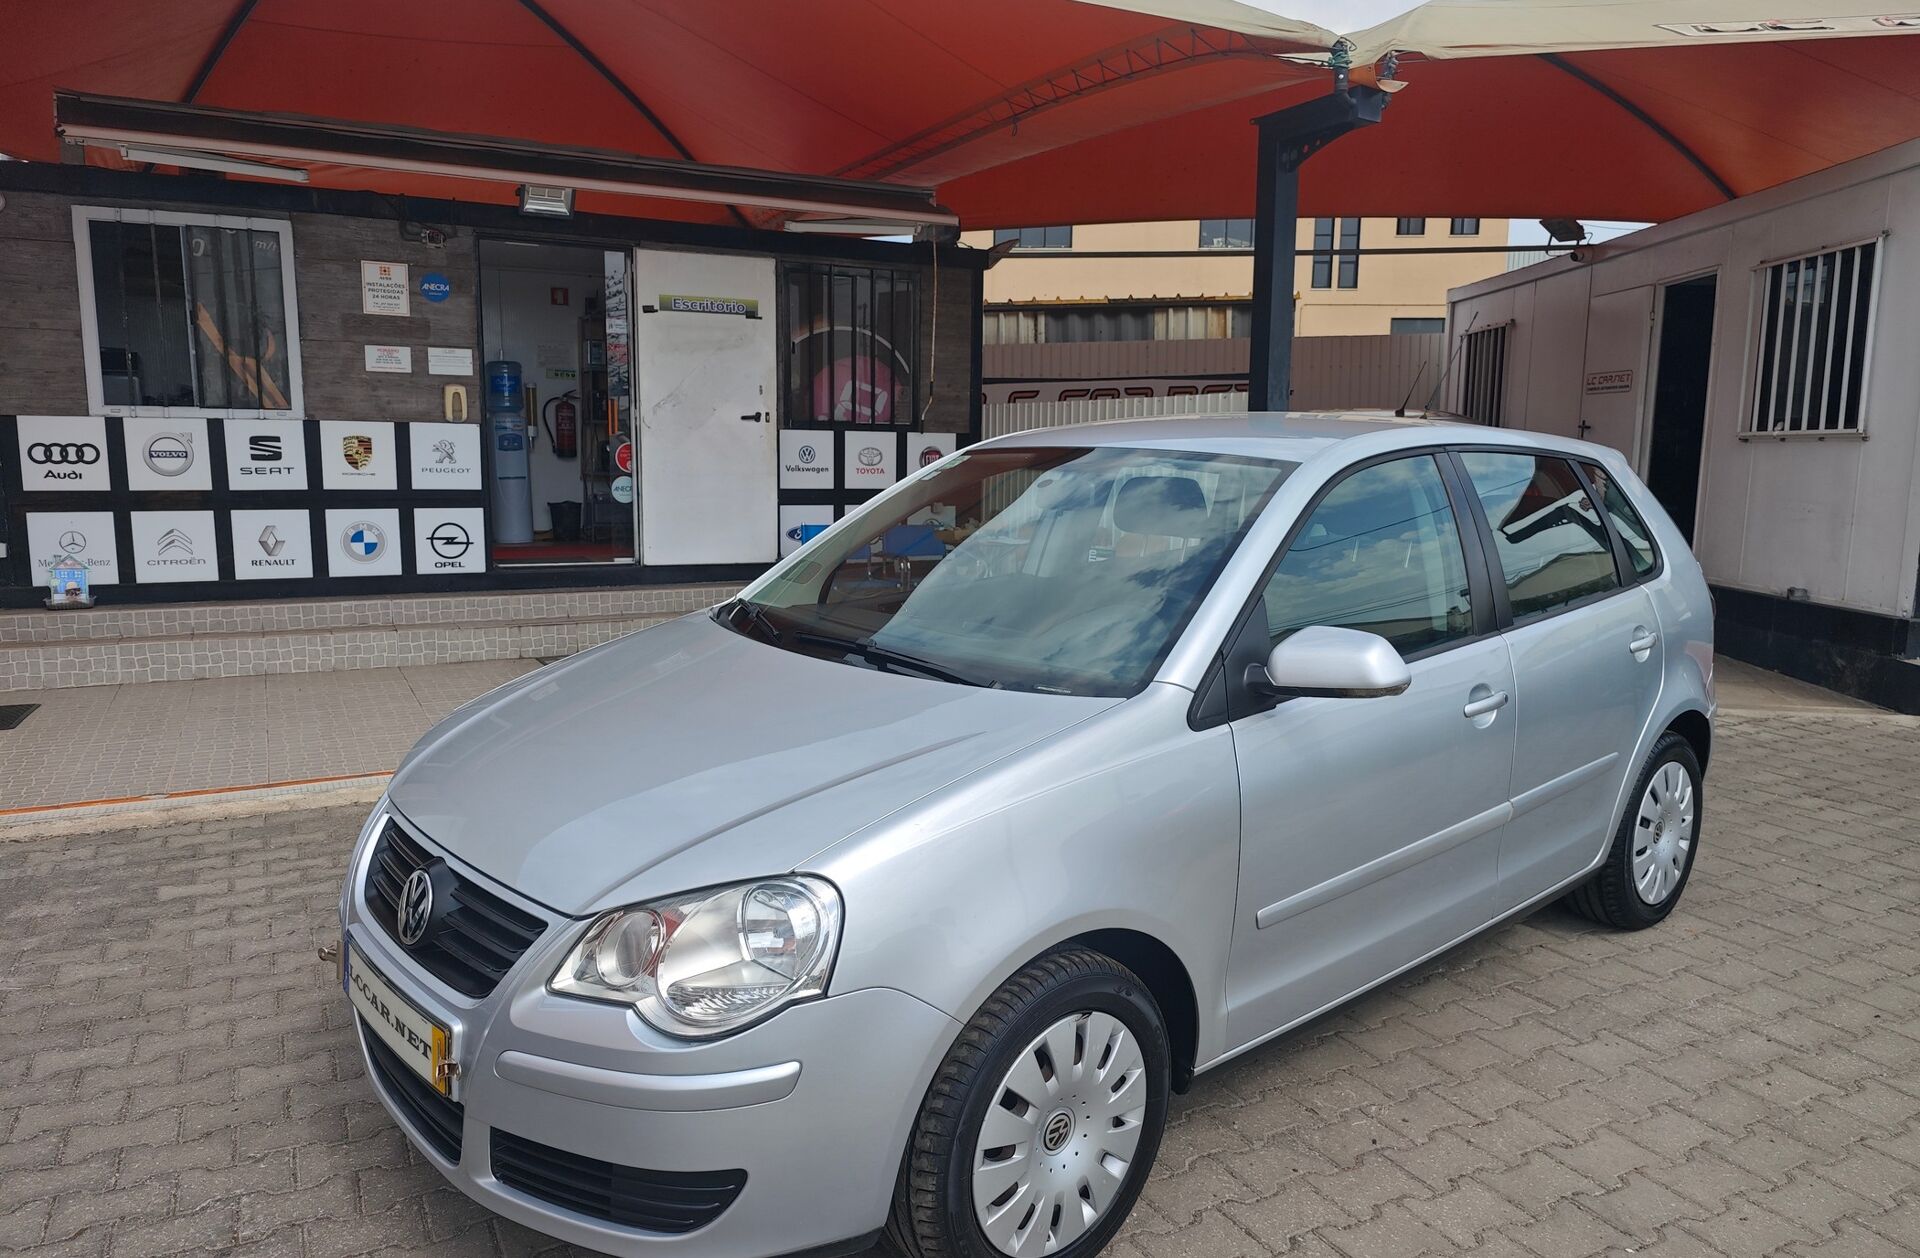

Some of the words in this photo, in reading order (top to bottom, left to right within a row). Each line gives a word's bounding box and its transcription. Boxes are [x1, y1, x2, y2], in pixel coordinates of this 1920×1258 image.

[421, 283, 450, 291] ANECRA
[672, 297, 747, 314] Escritório
[240, 467, 295, 475] SEAT
[785, 465, 829, 474] Volkswagen
[43, 470, 83, 480] Audi
[251, 558, 296, 567] RENAULT
[349, 964, 432, 1060] LCCAR.NET
